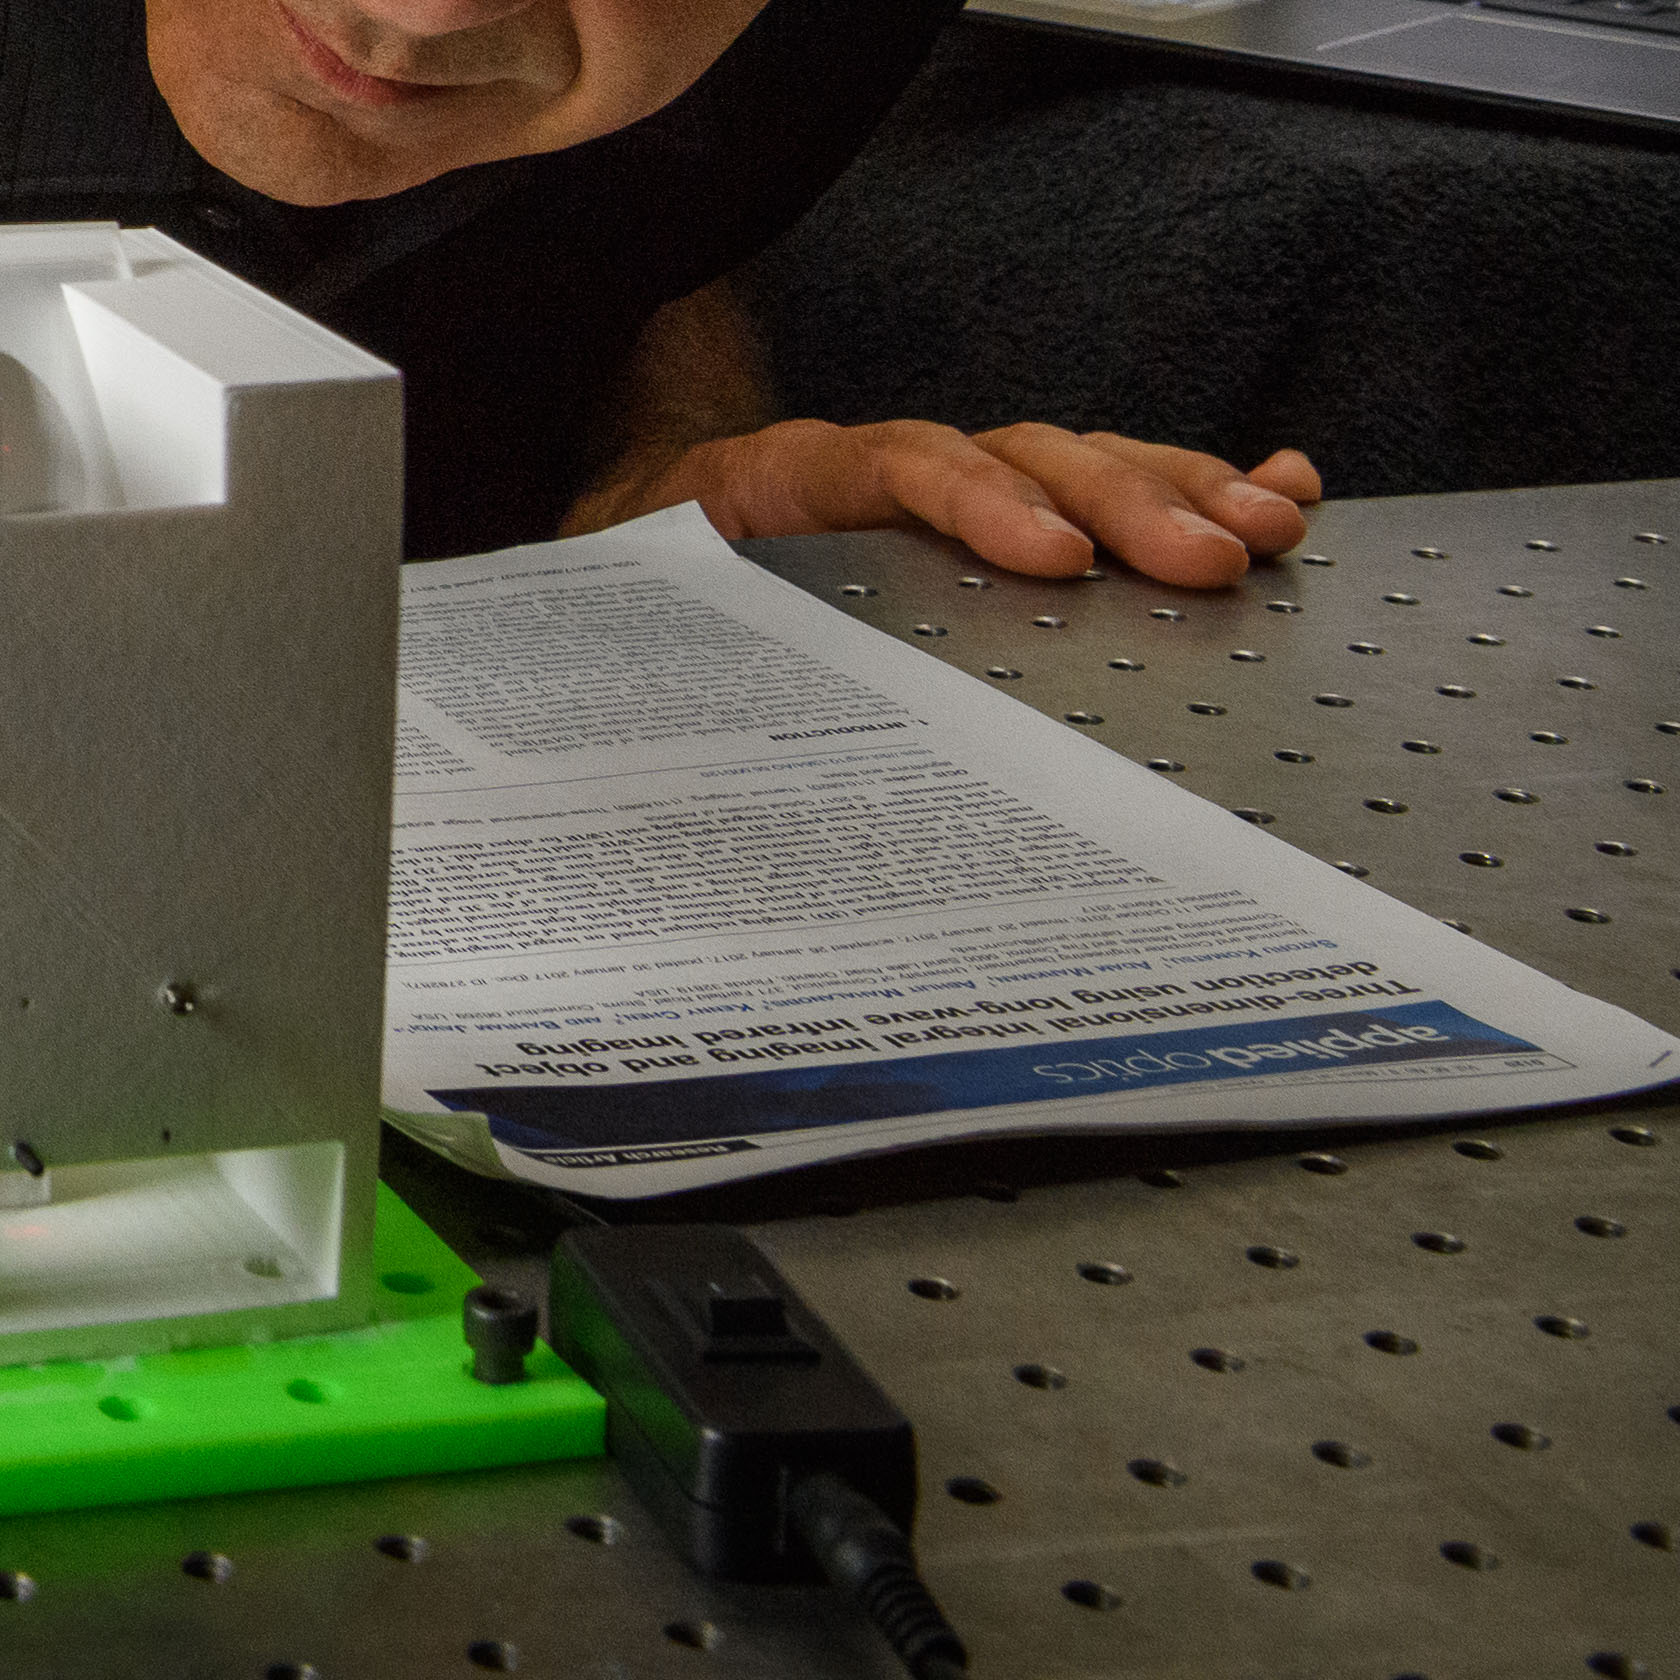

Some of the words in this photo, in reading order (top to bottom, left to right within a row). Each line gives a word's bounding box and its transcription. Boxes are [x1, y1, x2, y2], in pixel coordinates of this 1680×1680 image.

[768, 721, 906, 741] INTRODUCTION
[1192, 961, 1377, 991] detection
[1048, 980, 1418, 1031] Three-dimensional
[1070, 983, 1186, 1004] using
[864, 996, 1068, 1025] long-wave
[693, 1018, 859, 1045] infrared
[882, 1022, 1042, 1048] integral
[516, 1035, 687, 1055] imaging
[707, 1037, 878, 1062] imaging
[1207, 1024, 1448, 1067] applied
[476, 1061, 608, 1077] object
[619, 1054, 699, 1073] and
[1033, 1051, 1211, 1083] optics
[543, 1153, 617, 1167] Article
[622, 1144, 728, 1159] Research
